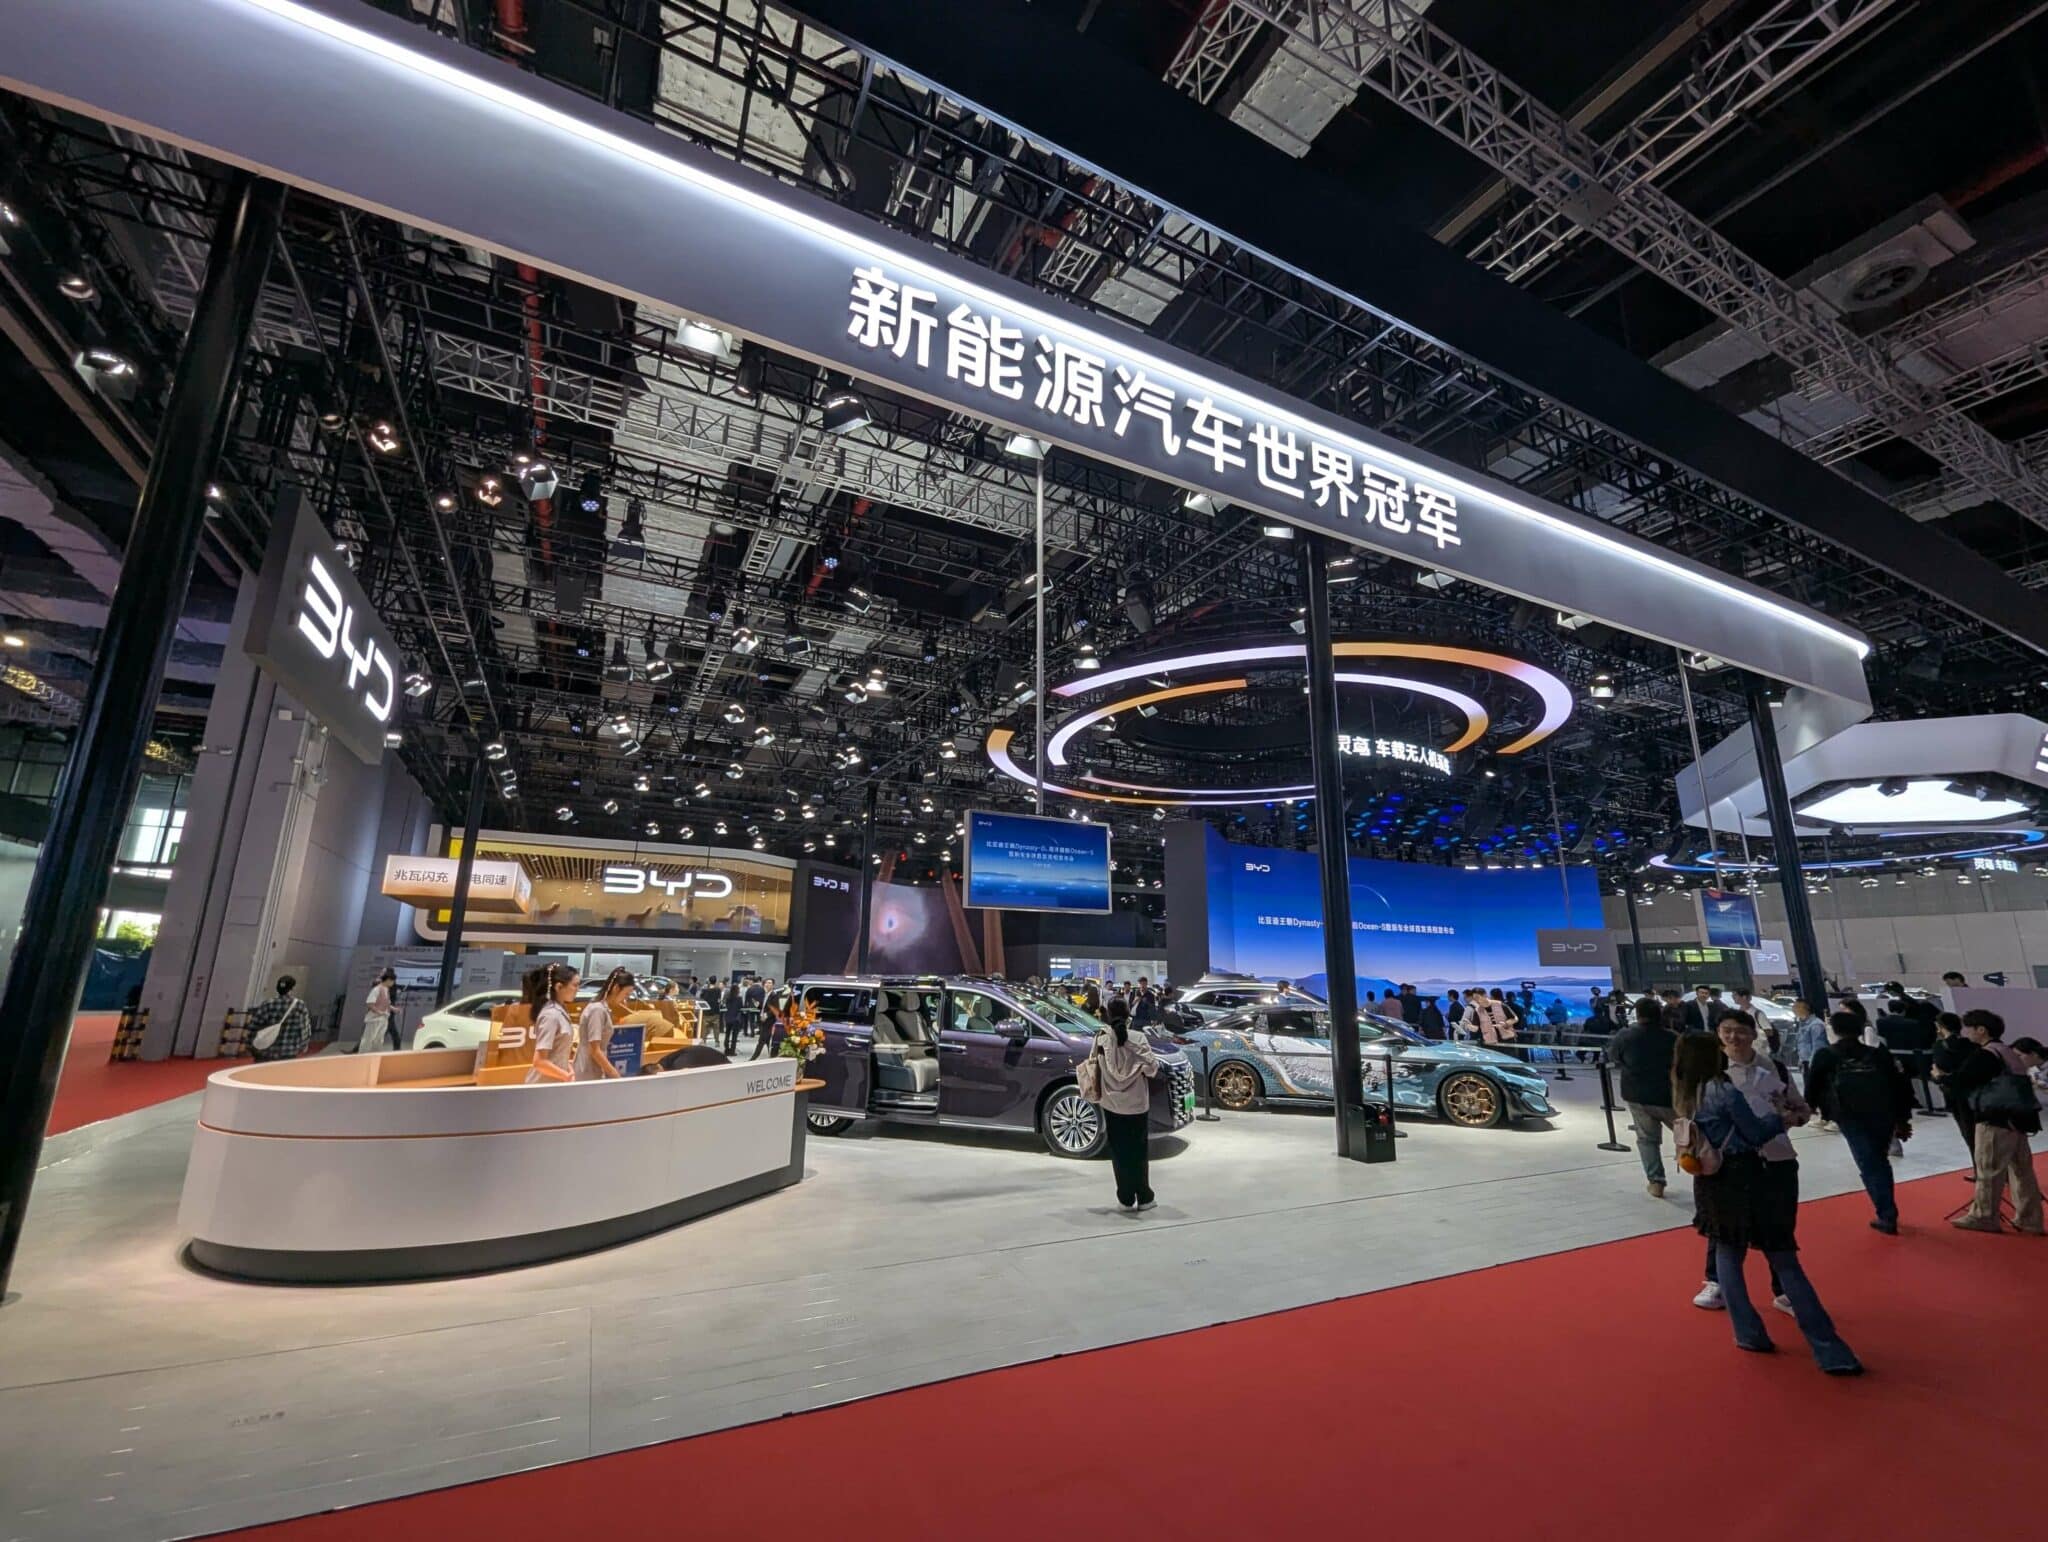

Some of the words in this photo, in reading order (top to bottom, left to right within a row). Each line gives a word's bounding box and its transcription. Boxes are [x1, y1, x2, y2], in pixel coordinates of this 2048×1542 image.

[847, 266, 1462, 549] 新能源汽车世界冠军
[298, 555, 394, 722] BYD
[393, 869, 449, 883] 兆瓦闪充
[471, 873, 507, 886] 电同速
[1245, 863, 1271, 873] BYD
[603, 867, 733, 898] BYD
[813, 876, 838, 889] BYD
[1552, 943, 1598, 952] BYD
[746, 1074, 792, 1095] WELCOME
